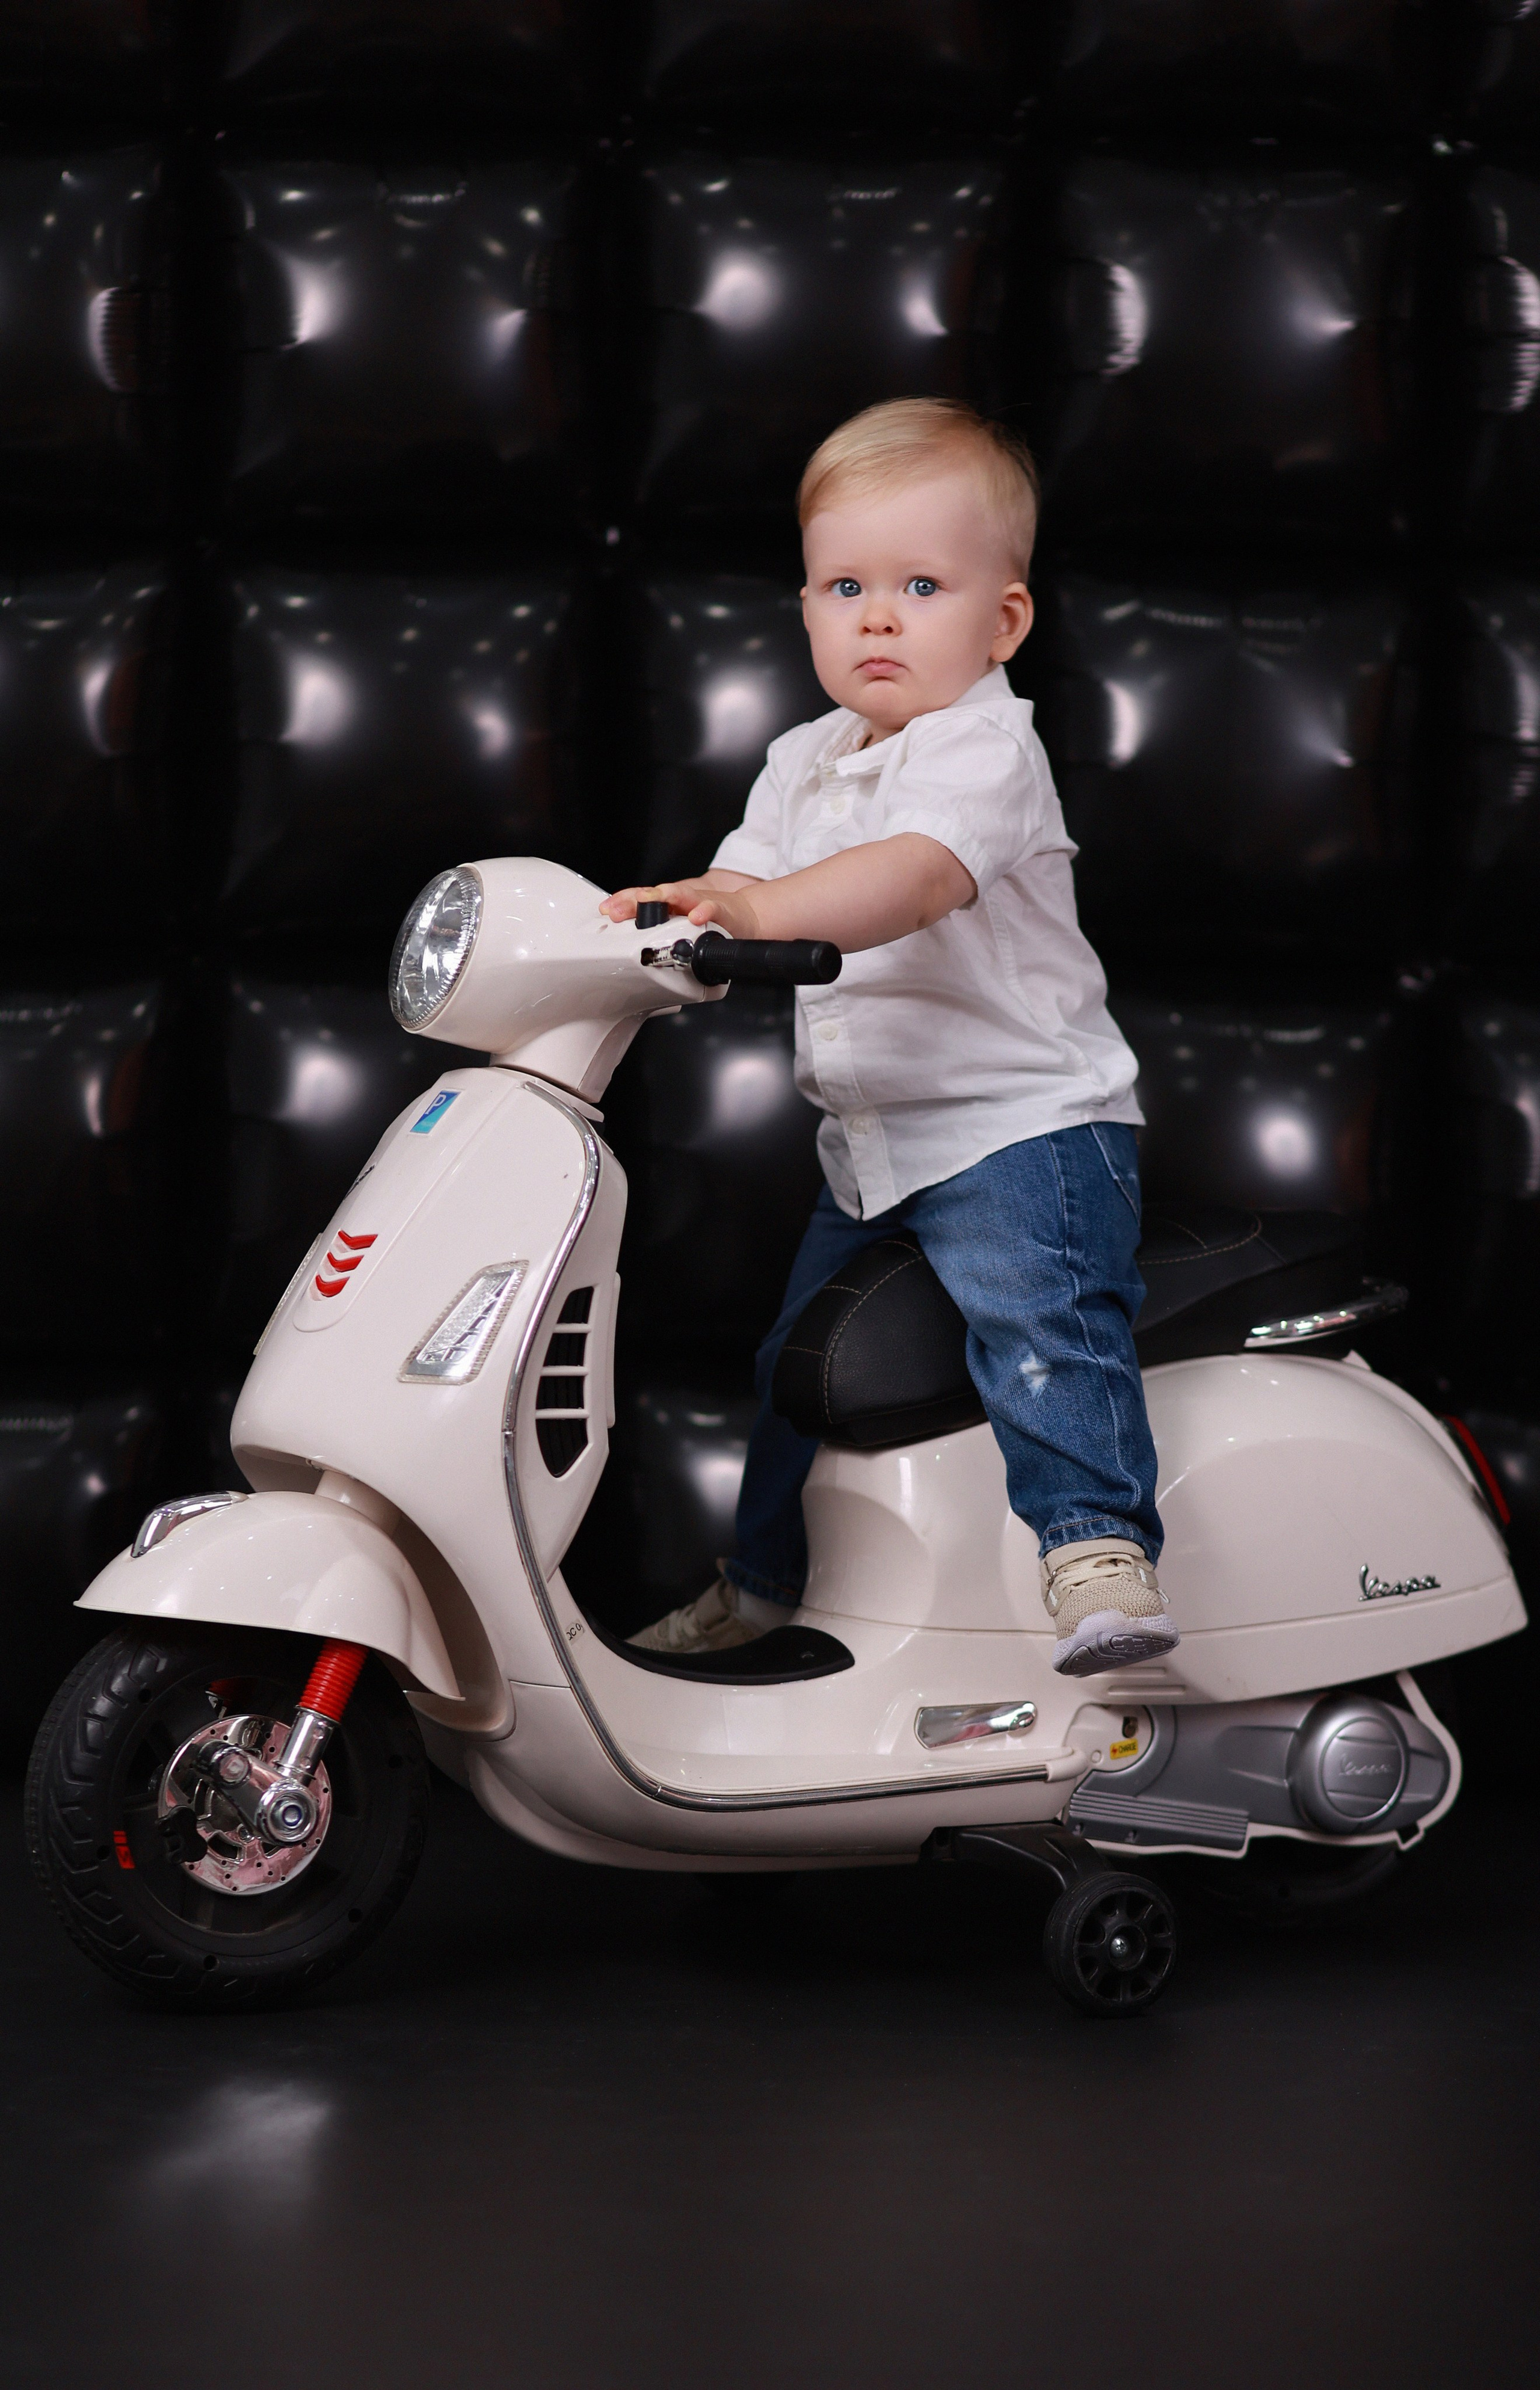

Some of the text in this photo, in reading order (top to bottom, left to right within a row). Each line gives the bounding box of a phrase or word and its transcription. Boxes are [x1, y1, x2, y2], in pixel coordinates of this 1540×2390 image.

[424, 1094, 446, 1115] P
[1358, 1563, 1441, 1602] Vespa
[1118, 1742, 1136, 1754] CHARGE
